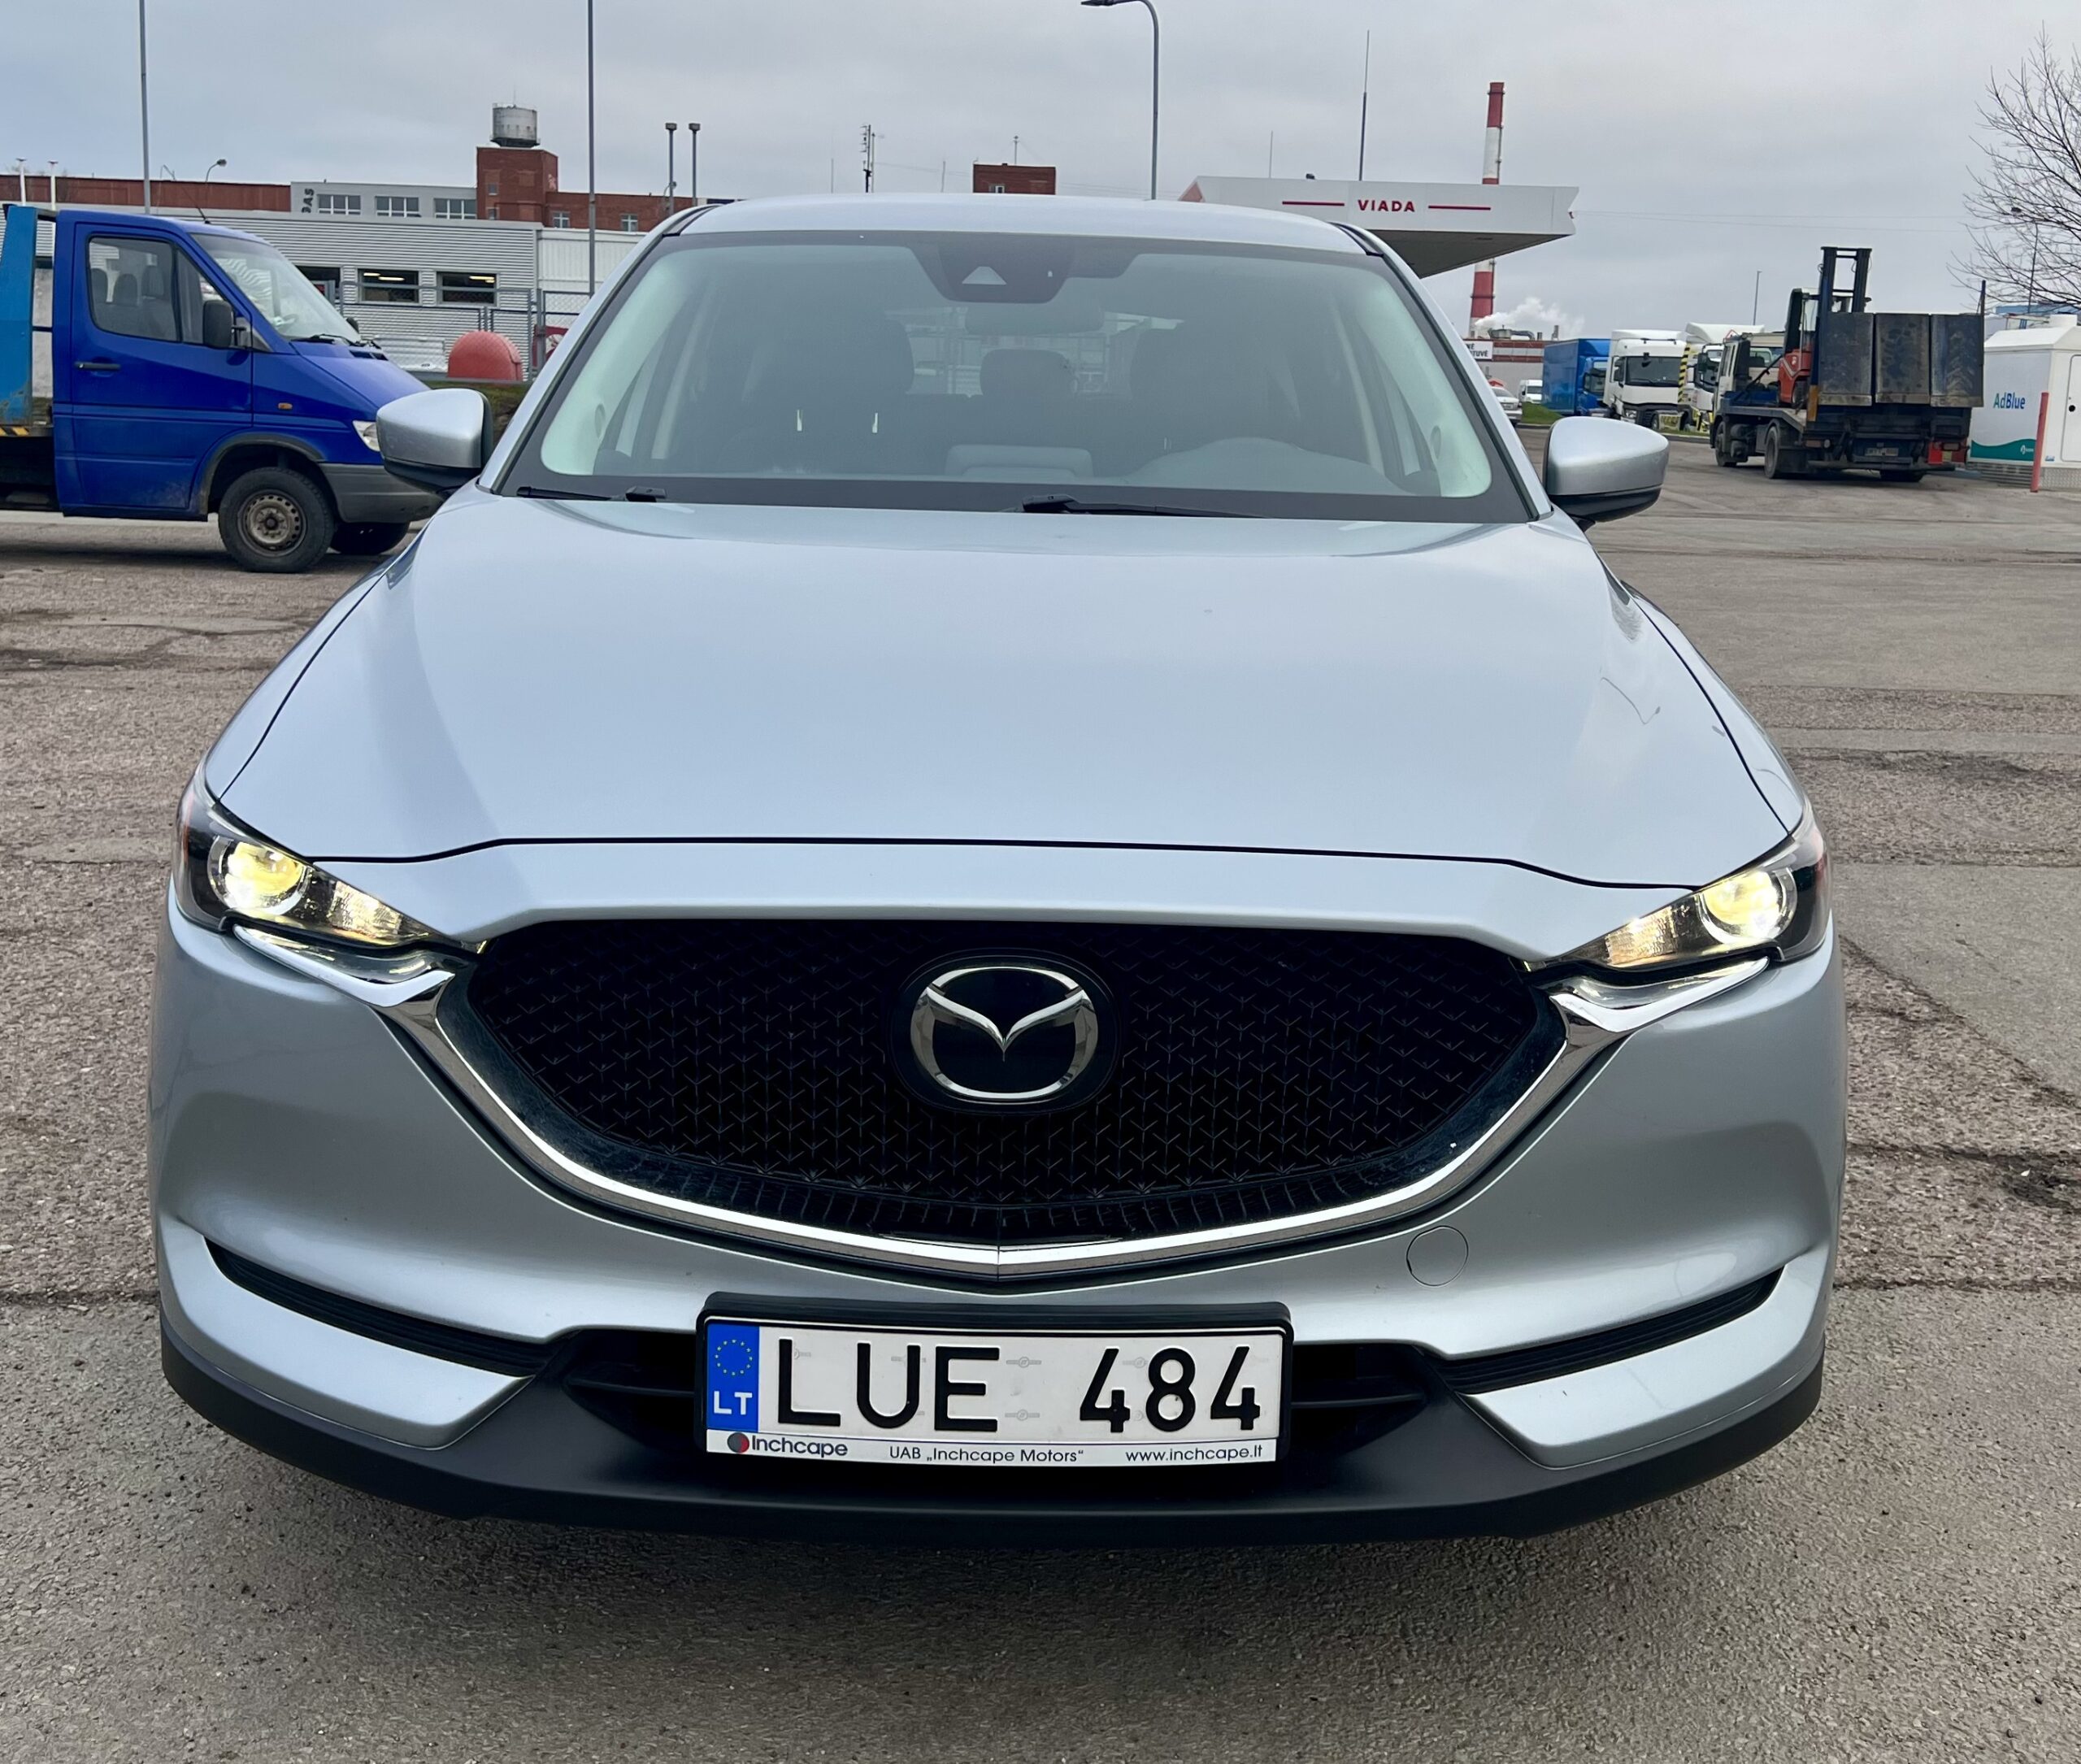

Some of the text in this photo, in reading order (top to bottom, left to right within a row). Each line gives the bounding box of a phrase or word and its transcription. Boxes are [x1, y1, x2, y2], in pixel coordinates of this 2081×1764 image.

[1358, 199, 1415, 212] VIADA
[1993, 392, 2026, 410] AdBlue
[778, 1338, 1261, 1433] LUE 484
[713, 1390, 753, 1415] LT
[751, 1435, 849, 1458] Inchcape
[890, 1446, 921, 1460] UAB
[1126, 1444, 1263, 1462] www.inchcape.lt
